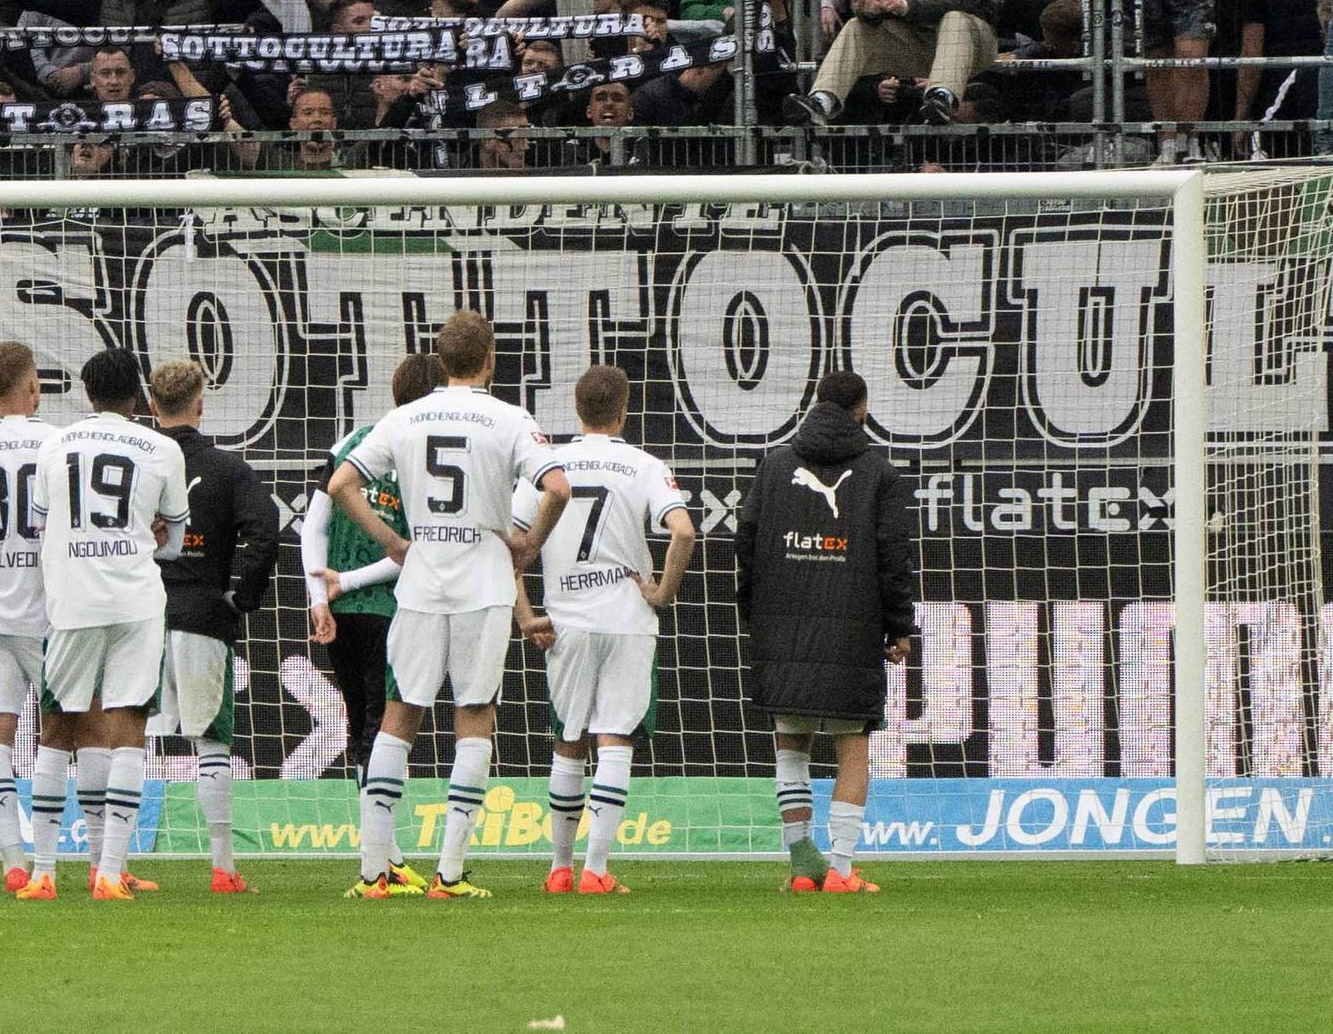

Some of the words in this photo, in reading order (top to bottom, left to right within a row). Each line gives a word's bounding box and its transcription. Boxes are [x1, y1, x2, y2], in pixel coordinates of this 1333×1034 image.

[66, 452, 136, 532] 19
[425, 435, 467, 514] 5
[68, 541, 137, 558] NGOUMOU
[568, 486, 615, 564] 7
